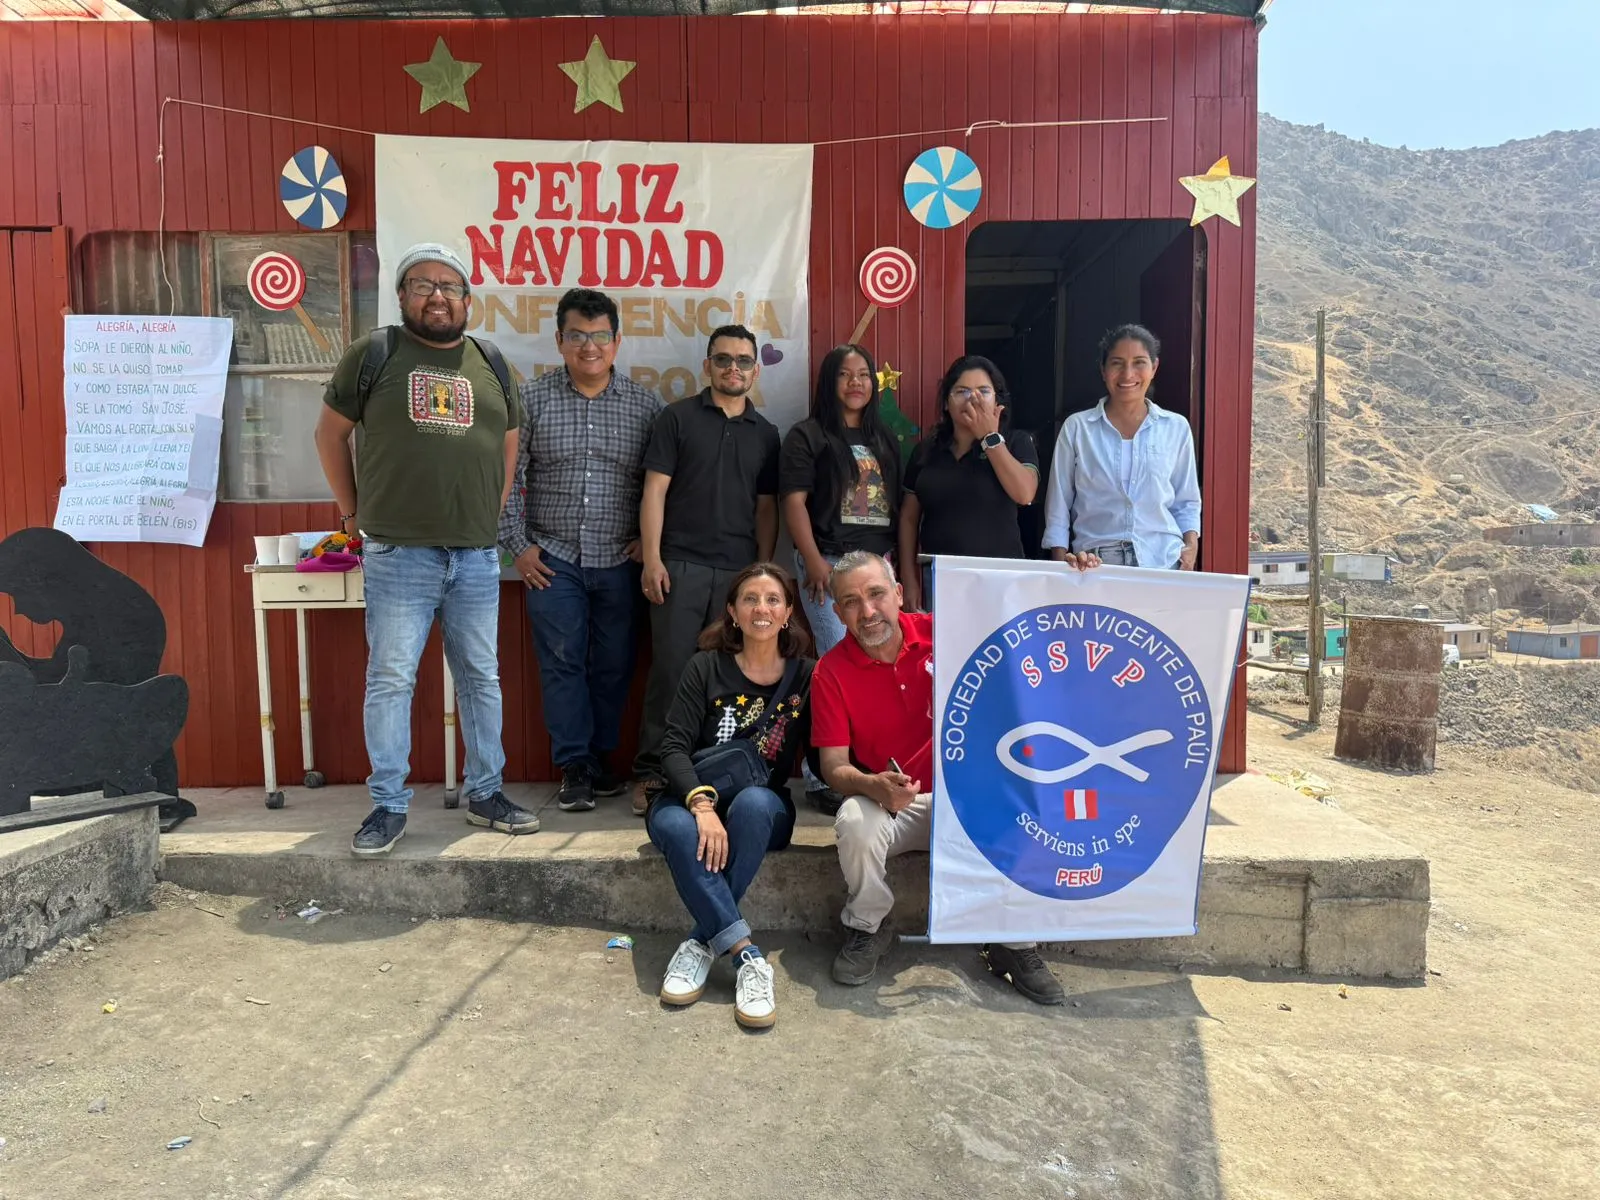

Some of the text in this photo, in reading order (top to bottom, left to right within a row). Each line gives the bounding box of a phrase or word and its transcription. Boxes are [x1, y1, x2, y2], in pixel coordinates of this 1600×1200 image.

[492, 160, 685, 224] FELIZ
[464, 224, 725, 289] NAVIDAD
[96, 320, 177, 334] ALEGRÍA, ALEGRÍA
[74, 340, 100, 353] SOPA
[105, 342, 117, 354] LE
[121, 342, 154, 354] DIERON
[158, 343, 168, 355] AL
[73, 362, 183, 375] NO SE LA QUISO TOMAR
[74, 382, 80, 393] Y
[86, 383, 111, 394] COMO
[116, 383, 150, 395] ESTABA
[153, 383, 169, 394] TAN
[76, 402, 89, 414] SE
[94, 403, 106, 414] LA
[106, 401, 132, 414] TOMÓ
[142, 402, 159, 415] SAN
[76, 421, 112, 434] VAMOS
[115, 424, 127, 434] AL
[417, 426, 446, 434] CUSCO
[74, 442, 91, 454] QUE
[74, 461, 84, 472] EL
[85, 461, 101, 473] QUE
[104, 461, 120, 472] NOS
[160, 461, 175, 471] CON
[177, 463, 187, 472] SU
[66, 496, 83, 507] ESTA
[84, 495, 110, 507] NOCHE
[112, 495, 134, 506] NACE
[136, 496, 146, 506] EL
[61, 514, 74, 526] EN
[76, 514, 85, 526] EL
[88, 514, 120, 526] PORTAL
[123, 514, 134, 526] DE
[945, 610, 1211, 769] SOCIEDAD DE SAN VICENTE DE PAÚL
[1016, 812, 1142, 857] serviens in spe
[1055, 862, 1103, 887] PERÚ
